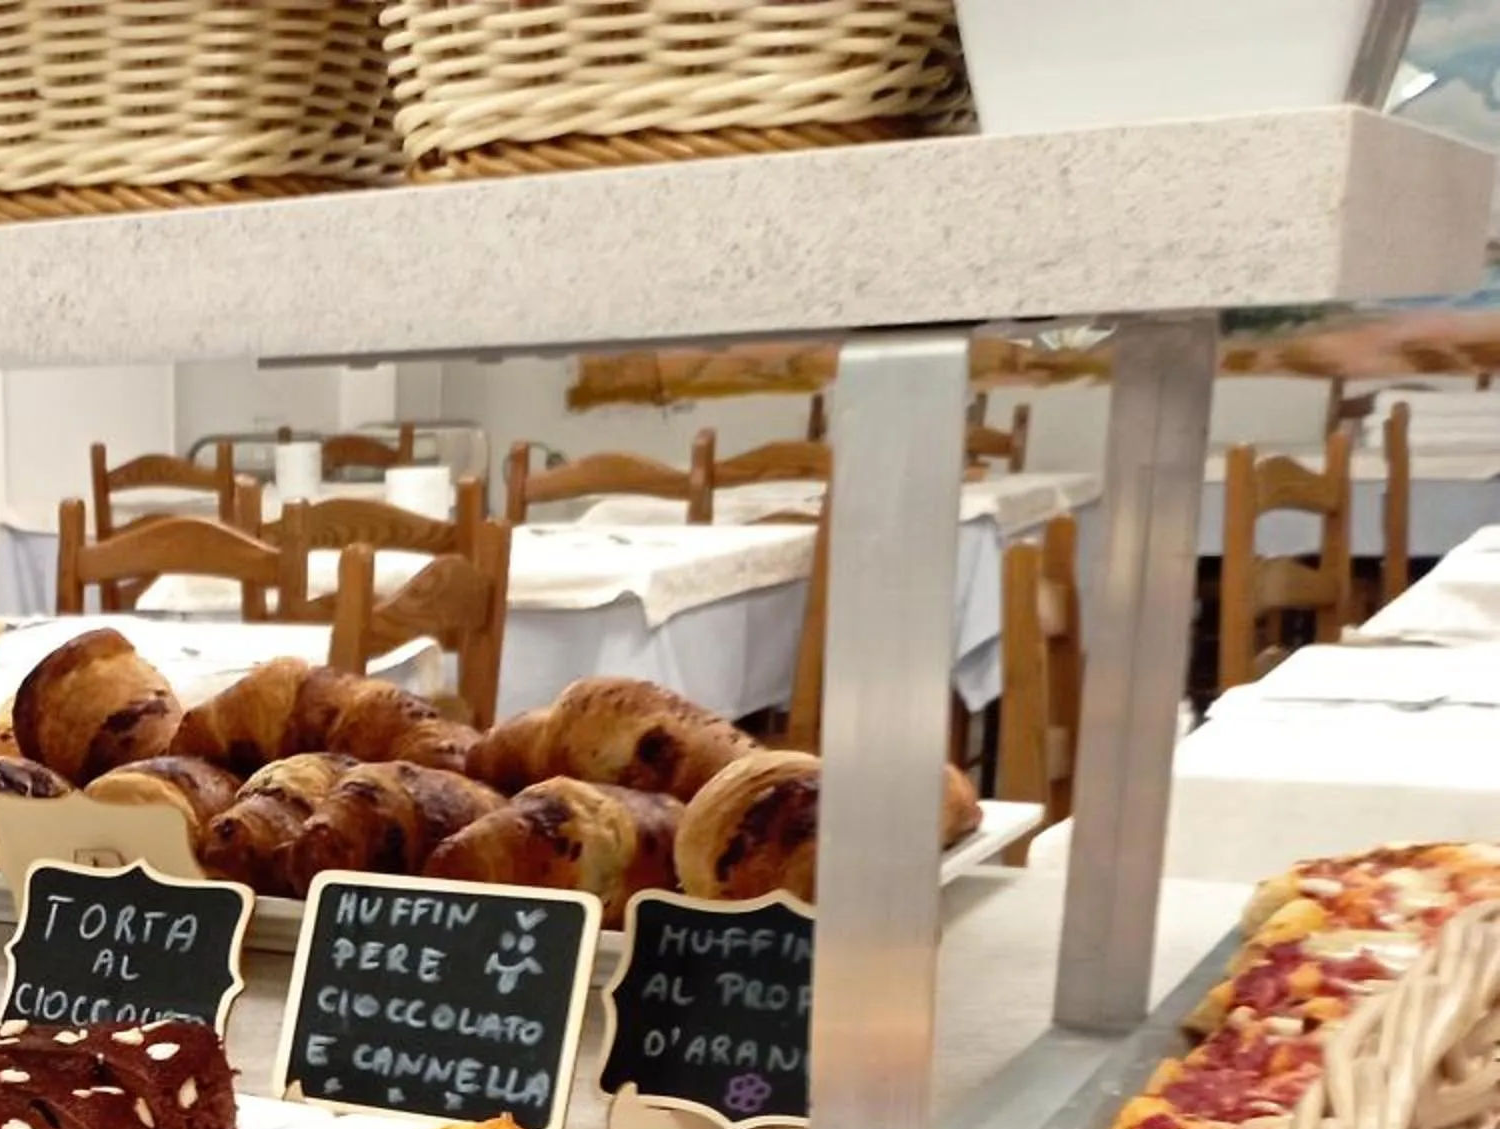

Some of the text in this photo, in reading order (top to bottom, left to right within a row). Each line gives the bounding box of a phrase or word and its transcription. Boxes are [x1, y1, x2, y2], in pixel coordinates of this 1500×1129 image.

[44, 894, 198, 952] TORTA
[91, 948, 141, 981] AL
[331, 936, 447, 983] PERE
[641, 971, 695, 1006] AL
[317, 985, 544, 1046] CIOCCOLATO
[305, 1034, 551, 1107] E CANNELLA
[642, 1025, 809, 1073] D'ARAN
